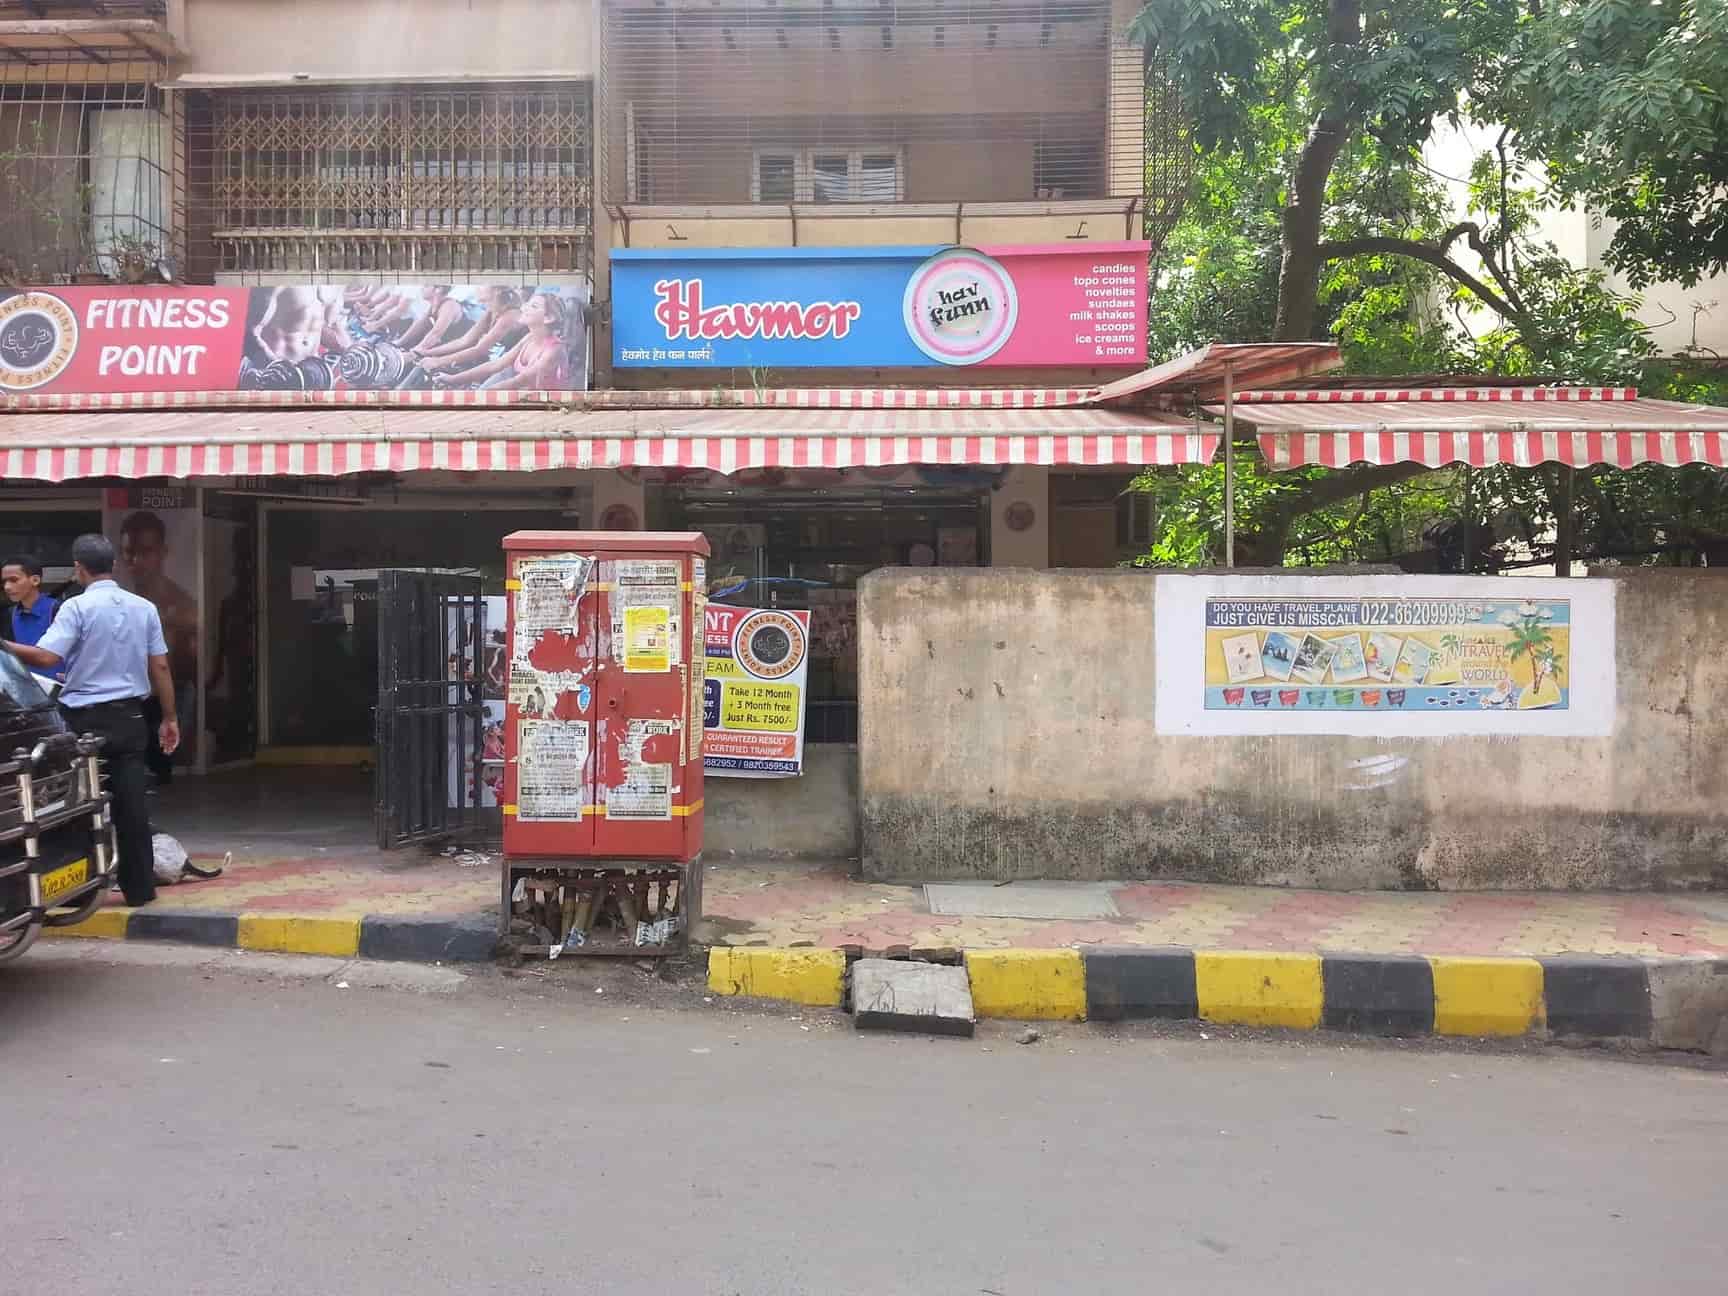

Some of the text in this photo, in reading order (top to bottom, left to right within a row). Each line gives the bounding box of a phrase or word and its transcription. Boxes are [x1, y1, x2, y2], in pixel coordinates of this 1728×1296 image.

[1092, 263, 1136, 273] candies
[1073, 275, 1136, 287] topo cones
[937, 282, 978, 305] hav
[1085, 286, 1136, 297] novelties
[654, 278, 861, 340] Havmor
[1088, 299, 1136, 309] sundaes
[86, 298, 230, 329] FITNESS
[929, 297, 991, 328] funn
[1069, 310, 1136, 321] milk shakes
[1095, 322, 1136, 333] scoops
[1075, 333, 1136, 344] ice creams
[1095, 345, 1136, 356] & more
[98, 344, 208, 376] POINT
[1213, 603, 1358, 613] DO YOU HAVE TRAVEL PLANS
[704, 611, 733, 632] NT
[1213, 613, 1359, 625] JUST GIVE US MISSCALL
[707, 634, 729, 645] ESS
[706, 662, 735, 673] EAM
[729, 687, 792, 699] Take 12 Month
[744, 701, 772, 711] Month
[774, 702, 792, 711] free
[727, 712, 744, 722] Just
